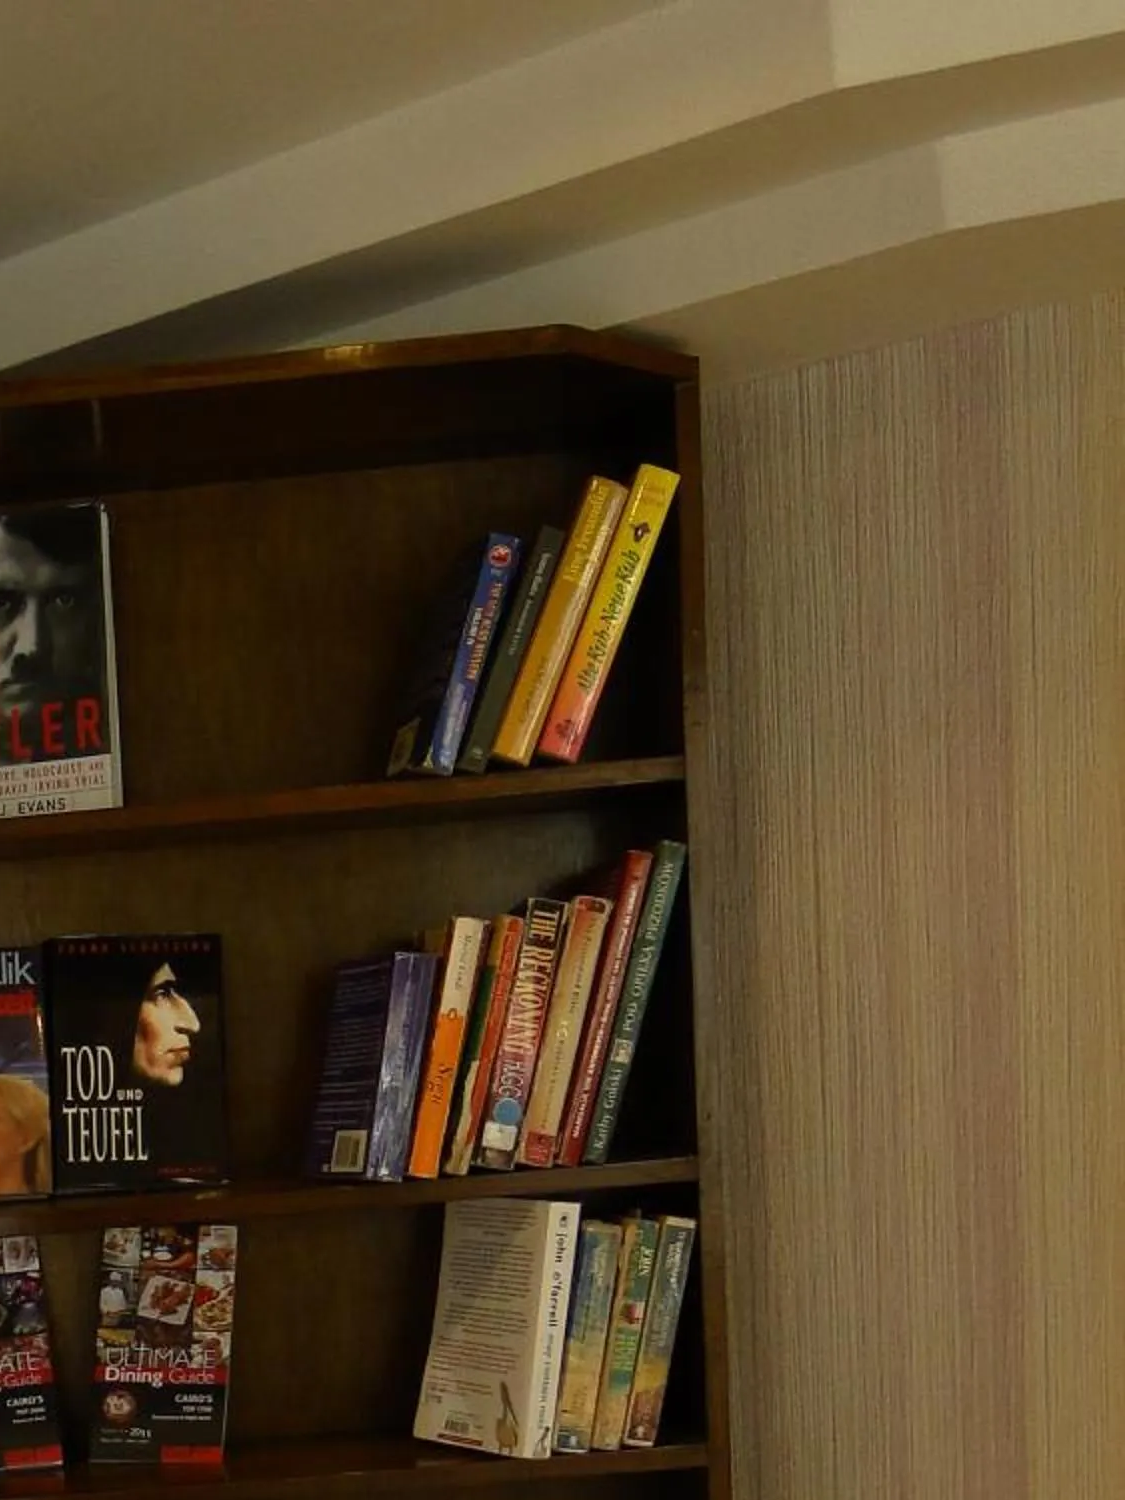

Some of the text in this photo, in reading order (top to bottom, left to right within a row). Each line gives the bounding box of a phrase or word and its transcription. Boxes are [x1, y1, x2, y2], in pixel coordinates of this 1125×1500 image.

[18, 797, 66, 814] EVANS
[527, 905, 560, 943] THE
[501, 942, 556, 1057] RECKONING
[60, 1045, 144, 1101] TOD UND
[590, 1113, 614, 1151] Kathy
[621, 1001, 639, 1032] POD
[62, 1104, 149, 1162] TEUFEL
[553, 1233, 569, 1263] john
[546, 1271, 564, 1326] o'farrell
[106, 1346, 216, 1369] ULTIMATE
[4, 1373, 42, 1388] Guide
[104, 1367, 216, 1388] Dining Guide
